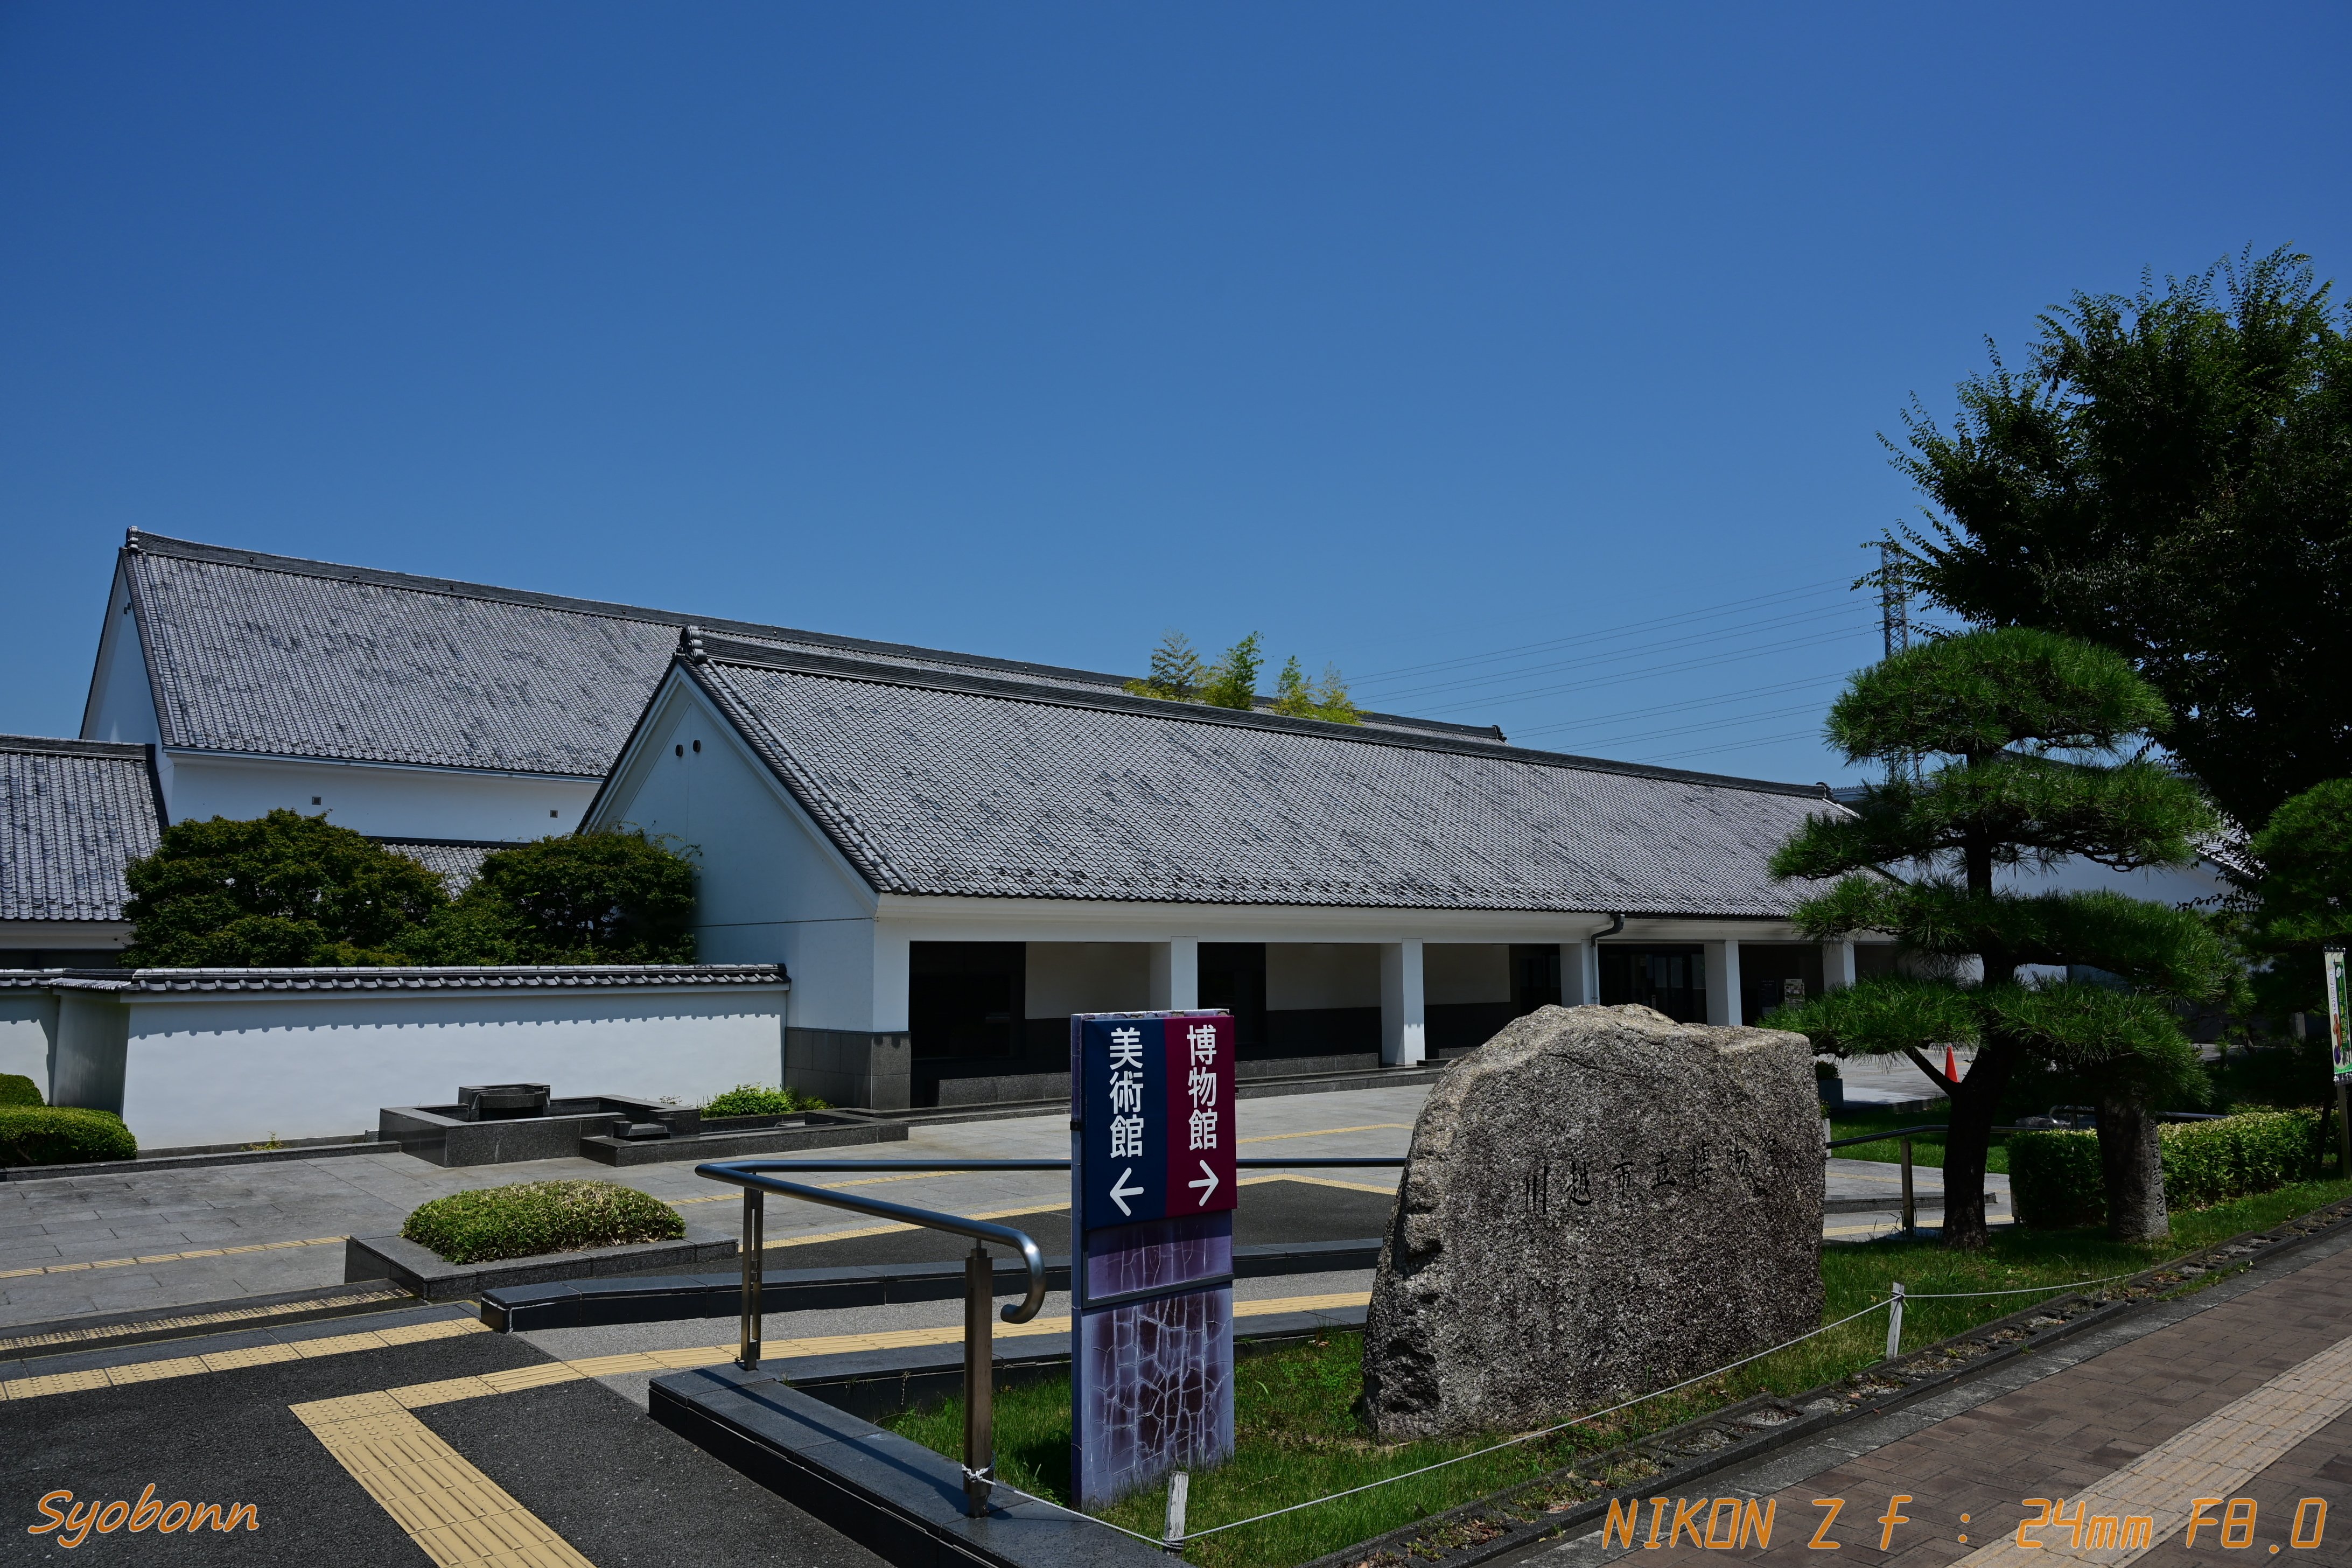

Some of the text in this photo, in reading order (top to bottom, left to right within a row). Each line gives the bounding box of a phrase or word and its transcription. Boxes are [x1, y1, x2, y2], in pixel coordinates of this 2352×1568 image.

[1110, 1027, 1144, 1158] 美術館
[1186, 1024, 1217, 1151] 博物館
